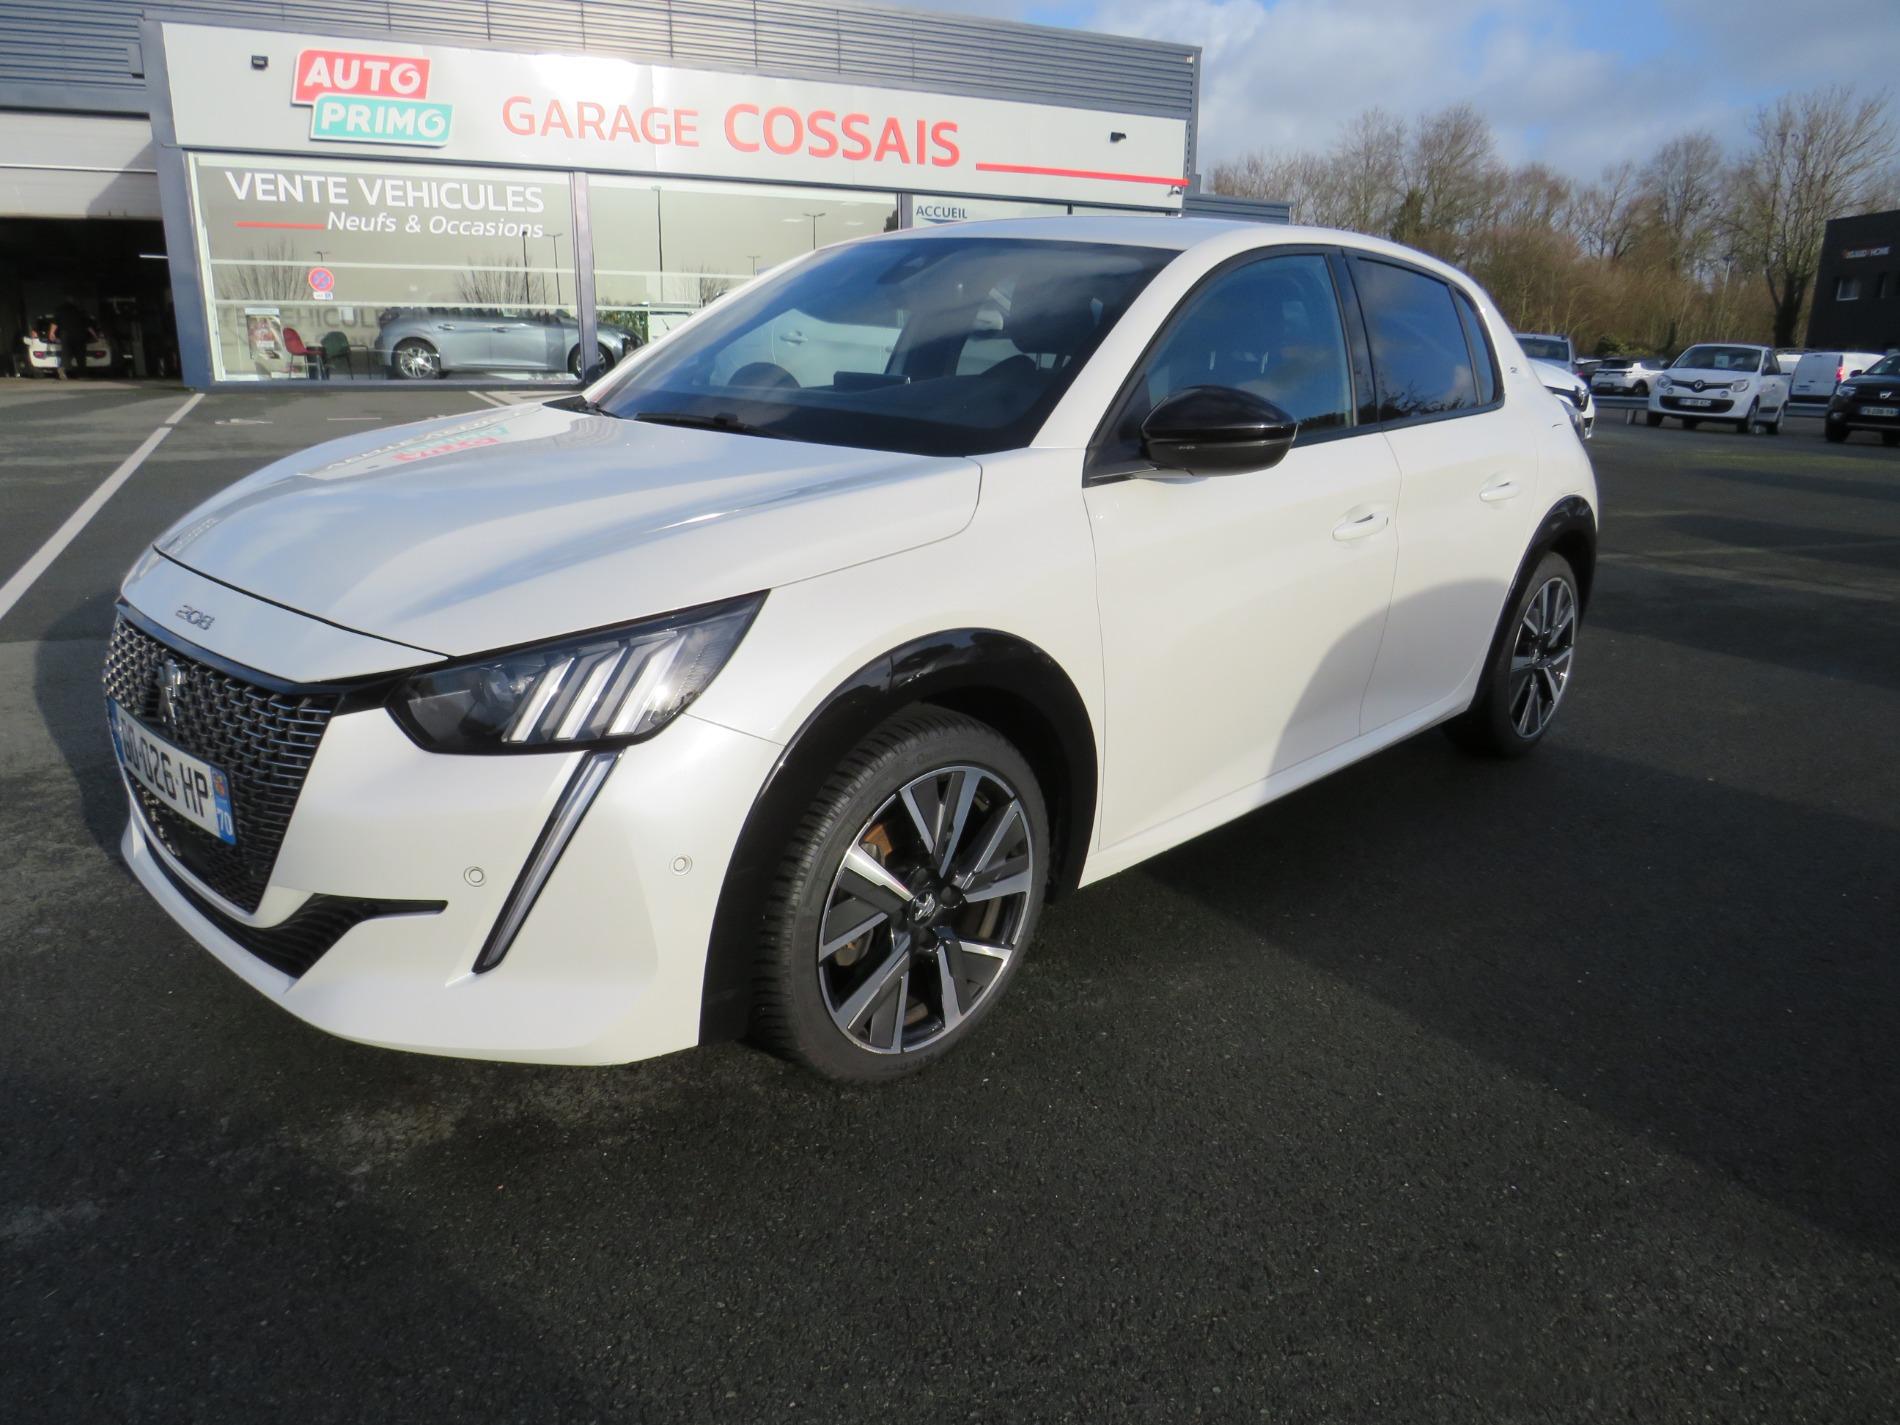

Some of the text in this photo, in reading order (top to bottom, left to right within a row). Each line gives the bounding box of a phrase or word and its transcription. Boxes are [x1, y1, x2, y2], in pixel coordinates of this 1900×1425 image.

[304, 56, 421, 94] AUTO
[321, 102, 446, 138] PRIMO
[502, 95, 961, 168] GARAGE COSSAIS
[225, 171, 545, 213] VENTE VEHICULES
[327, 211, 544, 238] Neufs & Occasions
[916, 205, 968, 219] ACCUEIL
[175, 604, 216, 631] 208
[216, 809, 234, 836] 70
